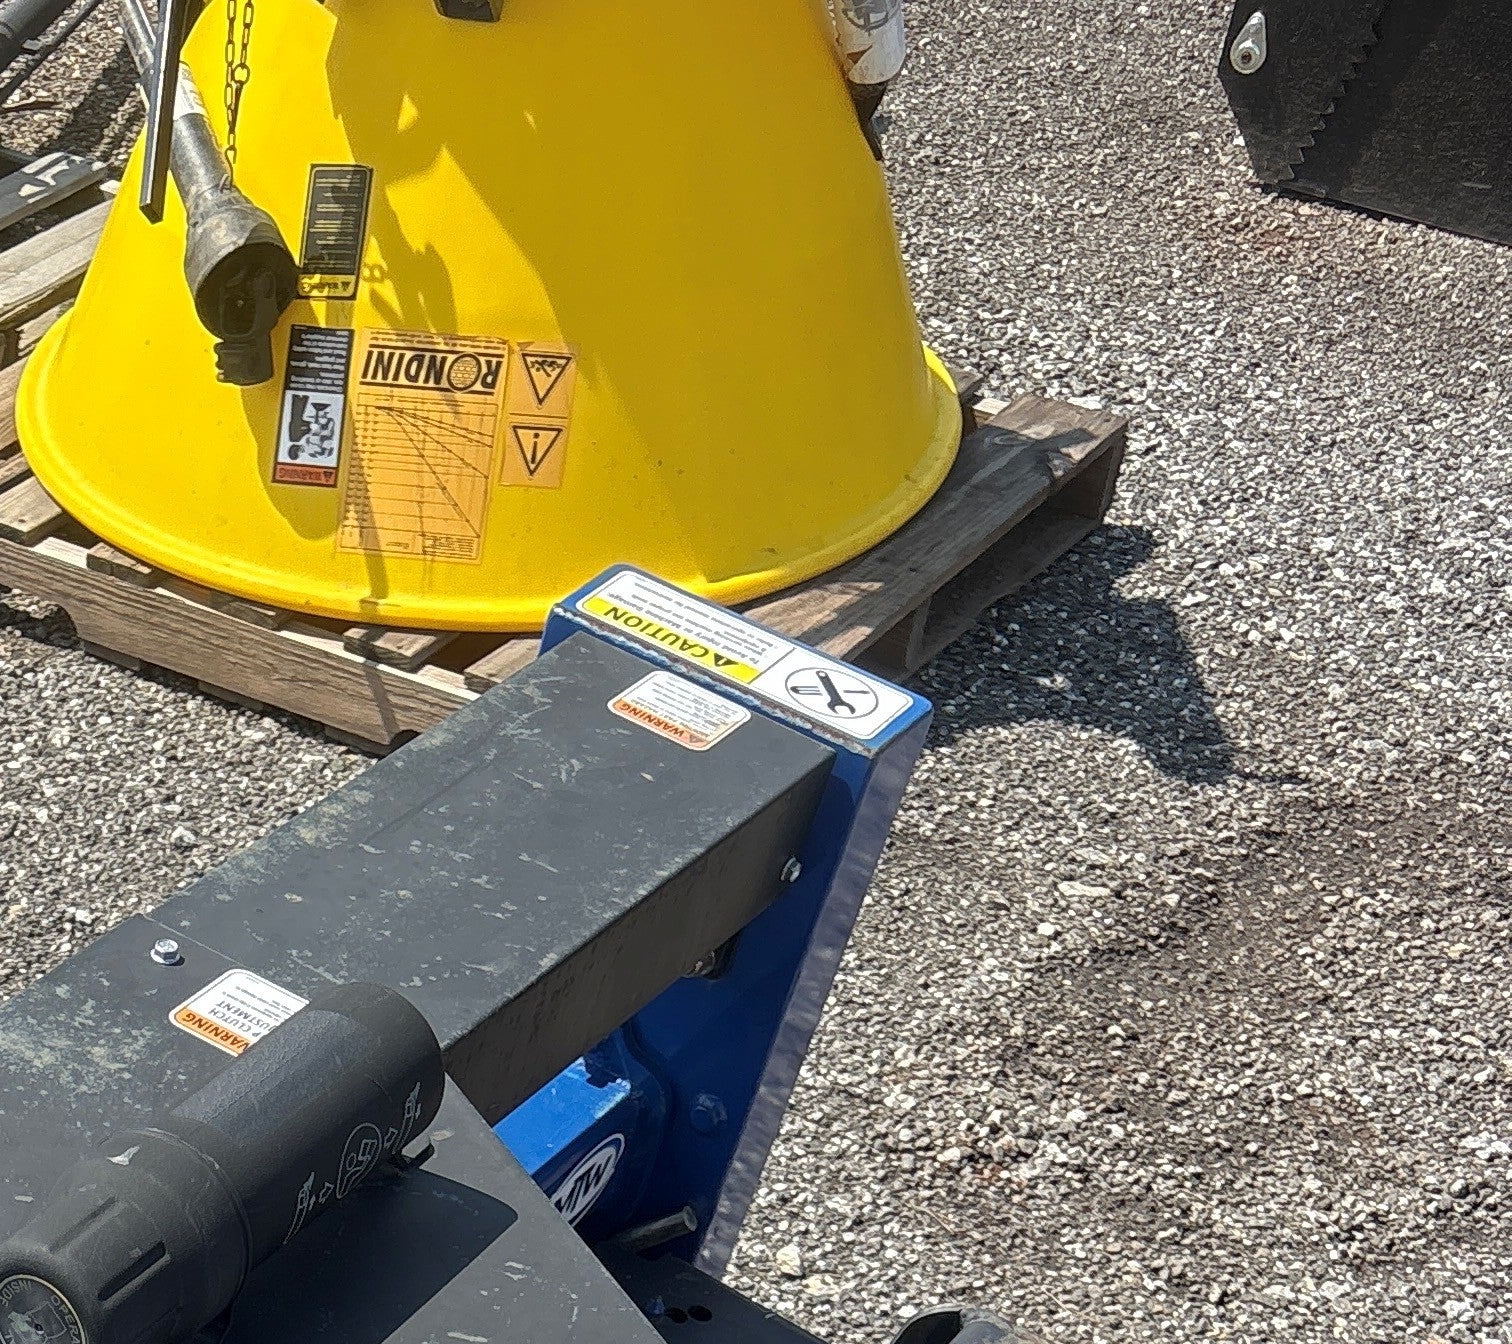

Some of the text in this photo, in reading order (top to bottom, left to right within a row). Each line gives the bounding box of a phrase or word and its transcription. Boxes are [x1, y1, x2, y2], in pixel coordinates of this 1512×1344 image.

[361, 349, 503, 395] RONDINI
[604, 606, 710, 658] CAUTION
[620, 704, 685, 737] WARNING
